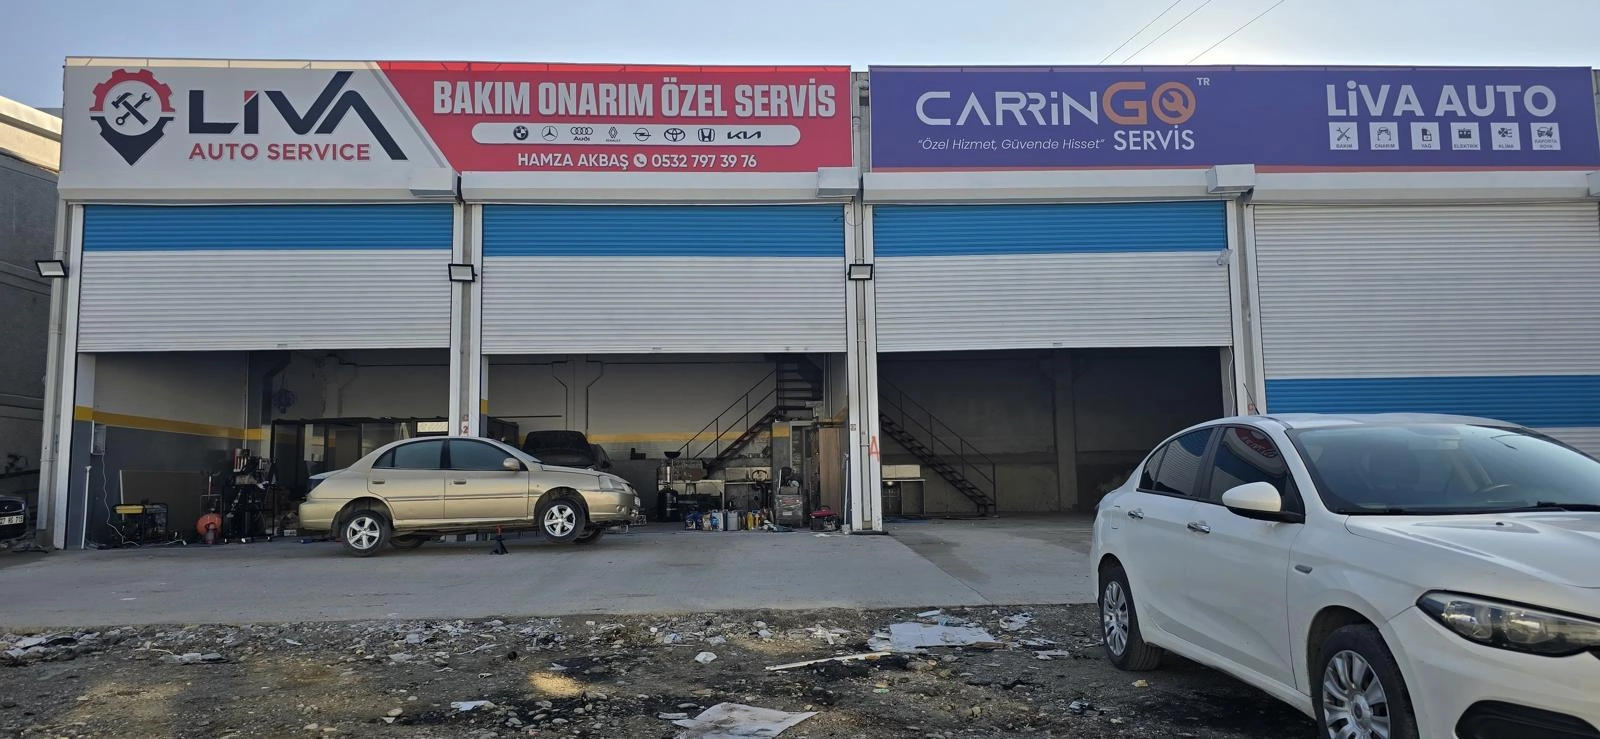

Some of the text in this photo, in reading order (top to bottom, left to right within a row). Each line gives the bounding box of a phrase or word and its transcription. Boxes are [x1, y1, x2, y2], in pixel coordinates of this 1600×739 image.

[1196, 77, 1210, 86] TR
[433, 77, 836, 117] BAKIM ONARIM ÖZEL SERVİS
[1435, 85, 1557, 117] AUTO
[952, 138, 998, 151] Hizmet,
[1001, 138, 1059, 150] Güvende
[1113, 125, 1195, 151] SERVİS
[189, 143, 370, 161] AUTO SERVICE
[518, 153, 757, 171] HAMZA AKBAŞ 0532 797 39 76
